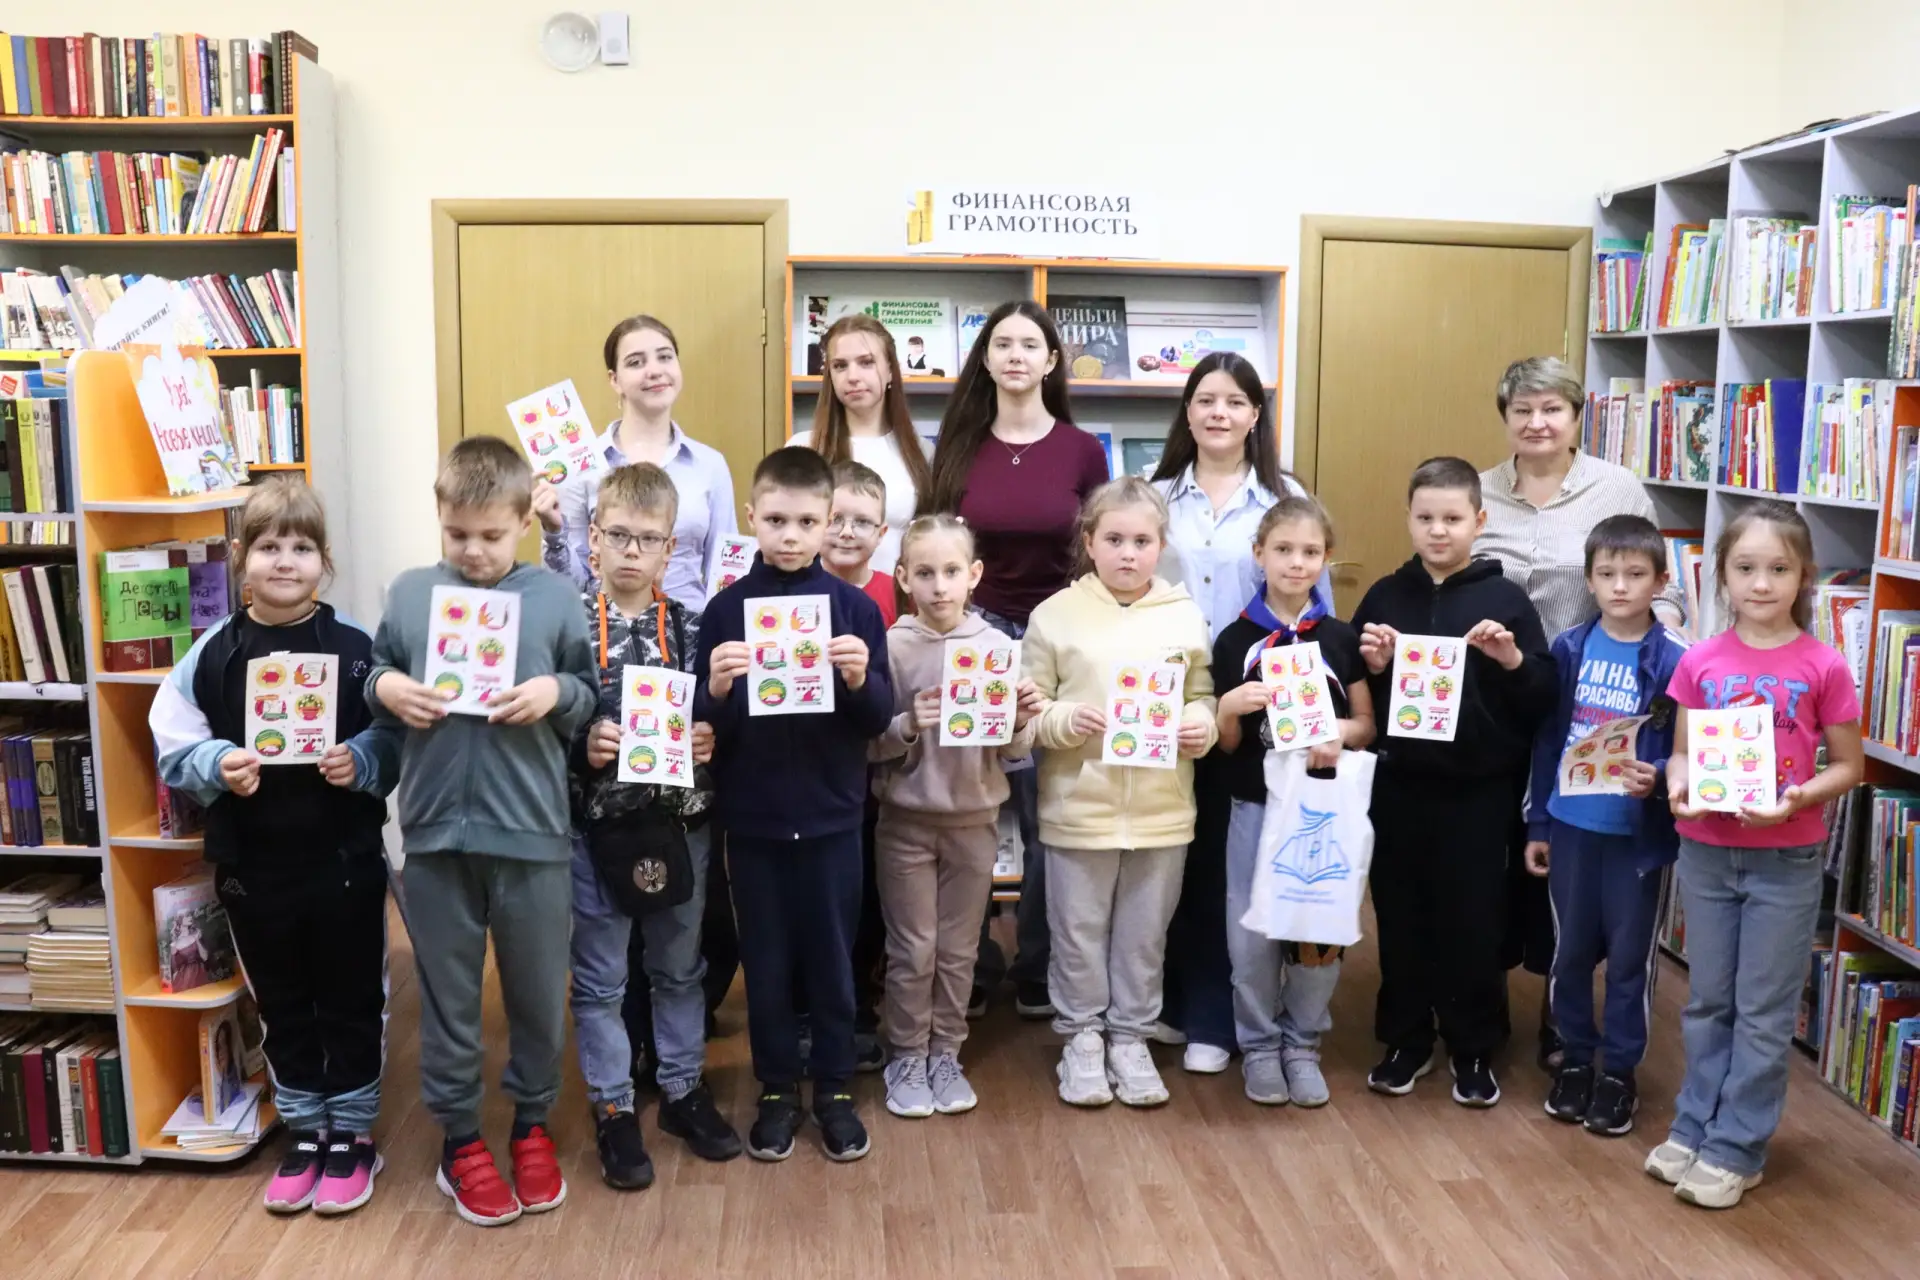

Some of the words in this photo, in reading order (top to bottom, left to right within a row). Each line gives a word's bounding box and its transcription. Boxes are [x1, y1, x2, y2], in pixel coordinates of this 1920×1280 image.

[952, 192, 1131, 213] ФИНАНСОВАЯ
[948, 214, 1138, 235] ГРАМОТНОСТЬ
[881, 301, 940, 309] ФИНАНСОВАЯ
[881, 309, 943, 317] ГРАМОТНОСТЬ
[140, 302, 171, 332] книги!
[881, 317, 933, 325] НАСЕЛЕНИЯ
[1578, 659, 1639, 692] УМНЫ
